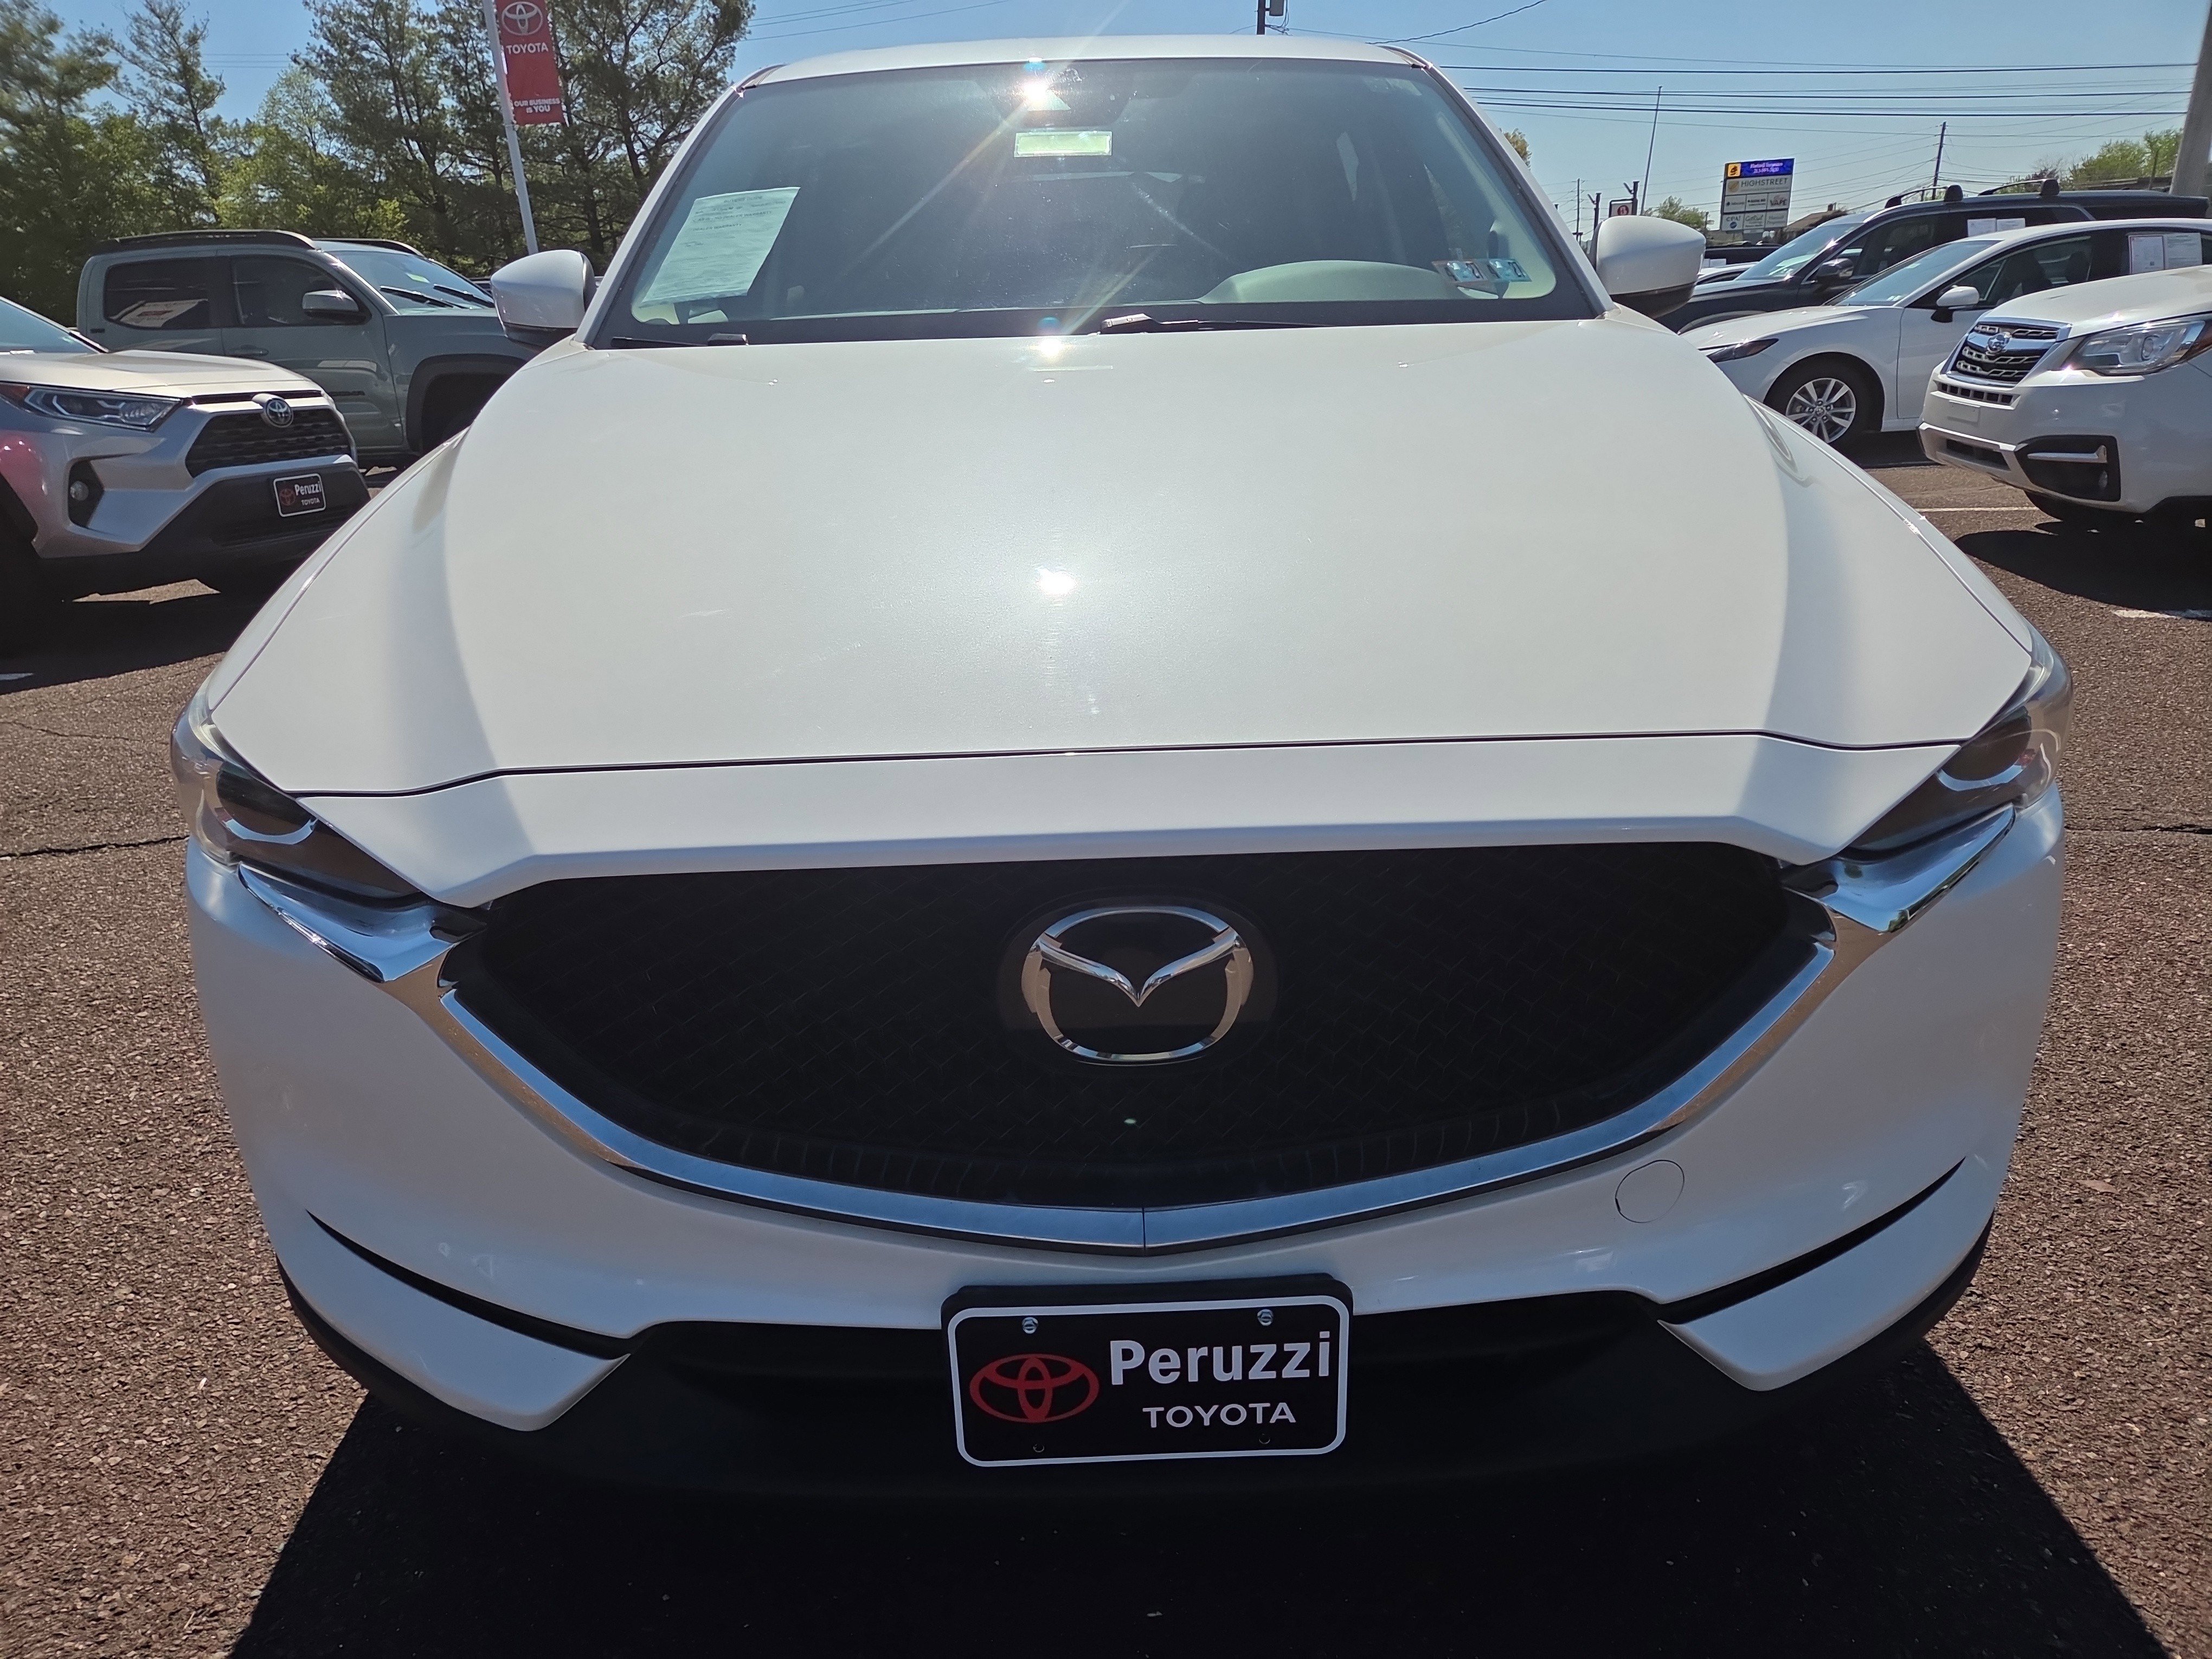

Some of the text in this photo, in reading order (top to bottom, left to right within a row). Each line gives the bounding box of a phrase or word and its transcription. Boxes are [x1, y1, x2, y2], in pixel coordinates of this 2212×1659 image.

[506, 42, 549, 55] TOYOTA
[533, 104, 550, 113] YOU
[1740, 178, 1787, 187] HIGHSTREET
[294, 481, 321, 496] Peruzzi
[301, 497, 320, 506] TOYOTA
[1109, 1330, 1330, 1386] Peruzzi
[1142, 1401, 1297, 1429] TOYOTA
